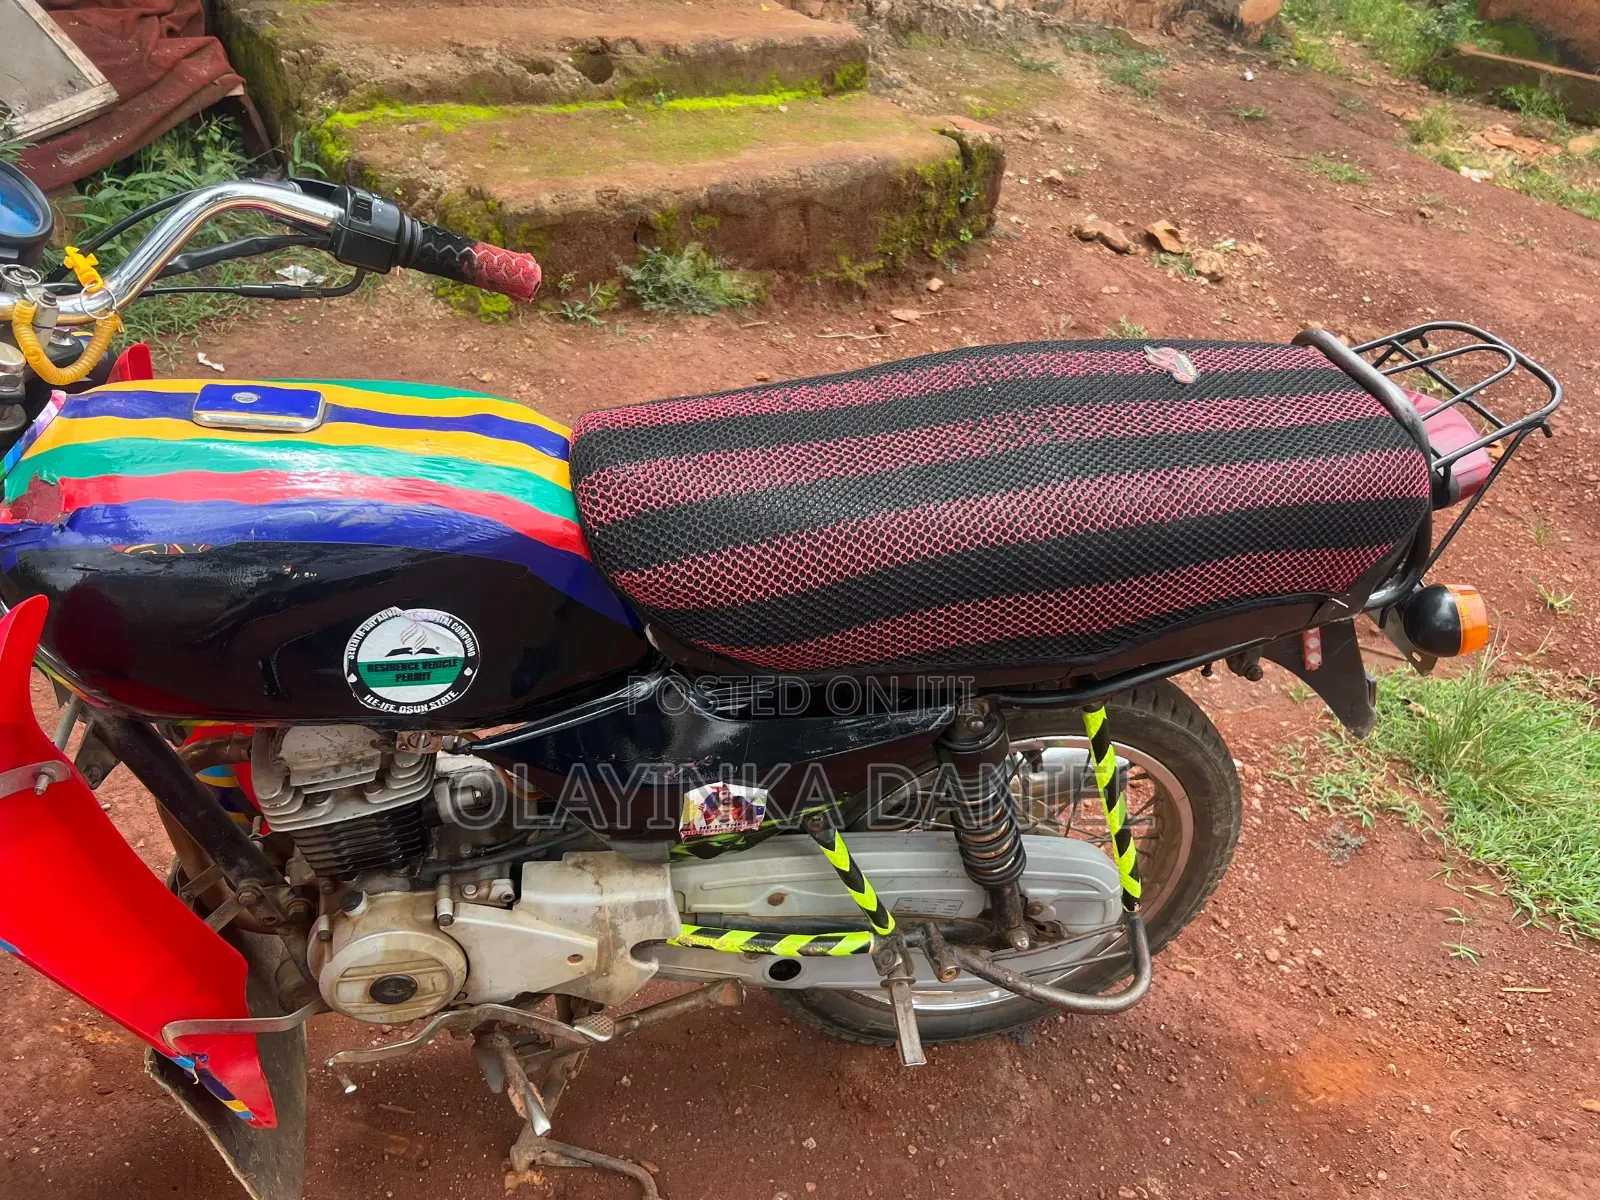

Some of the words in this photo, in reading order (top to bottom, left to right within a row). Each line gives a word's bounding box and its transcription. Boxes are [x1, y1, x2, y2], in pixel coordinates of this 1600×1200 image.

[450, 621, 476, 657] COMPOUND
[367, 662, 420, 673] RESIDENCE
[421, 658, 458, 670] VEHICLE
[395, 671, 431, 682] PERMIT
[398, 704, 428, 714] OSUN
